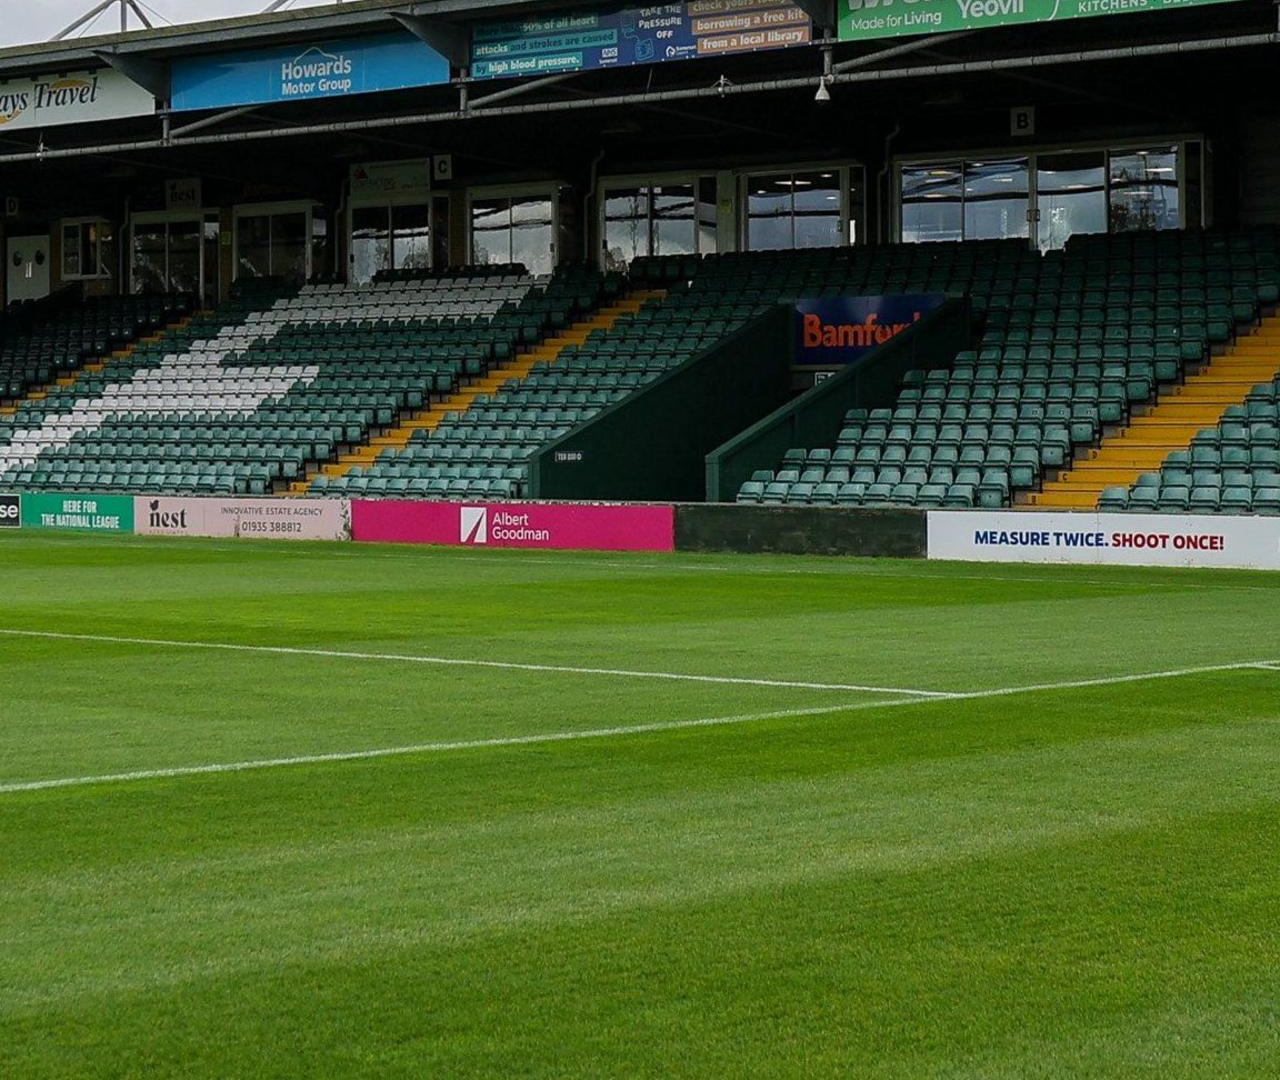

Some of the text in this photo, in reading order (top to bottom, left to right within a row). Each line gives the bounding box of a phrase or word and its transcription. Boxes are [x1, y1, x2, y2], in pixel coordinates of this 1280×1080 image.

[640, 4, 681, 18] TAKE THE
[693, 0, 722, 11] check
[638, 17, 682, 29] PRESSURE
[697, 9, 804, 32] borrowing a free kit
[851, 11, 942, 31] Made for Living
[656, 30, 673, 40] OFF
[703, 30, 804, 50] from a local library
[476, 43, 508, 55] attacks
[602, 48, 618, 57] NHS
[282, 57, 352, 81] Howards
[488, 61, 508, 75] high
[510, 58, 535, 70] blood
[34, 77, 98, 109] Travel
[282, 78, 352, 95] Motor Group
[1016, 112, 1029, 129] B
[438, 160, 447, 173] C
[803, 311, 921, 347] Bamfor
[62, 500, 97, 513] HERE FOR
[221, 506, 322, 517] INNOVATIVE ESTATE AGENCY
[41, 514, 119, 529] THE NATIONAL LEAGUE
[149, 508, 187, 528] nest
[492, 512, 529, 526] Albert
[242, 521, 302, 533] 01935 388812
[492, 527, 549, 541] Goodman
[975, 531, 1224, 551] MEASURE TWICE. SHOOT ONCE!
